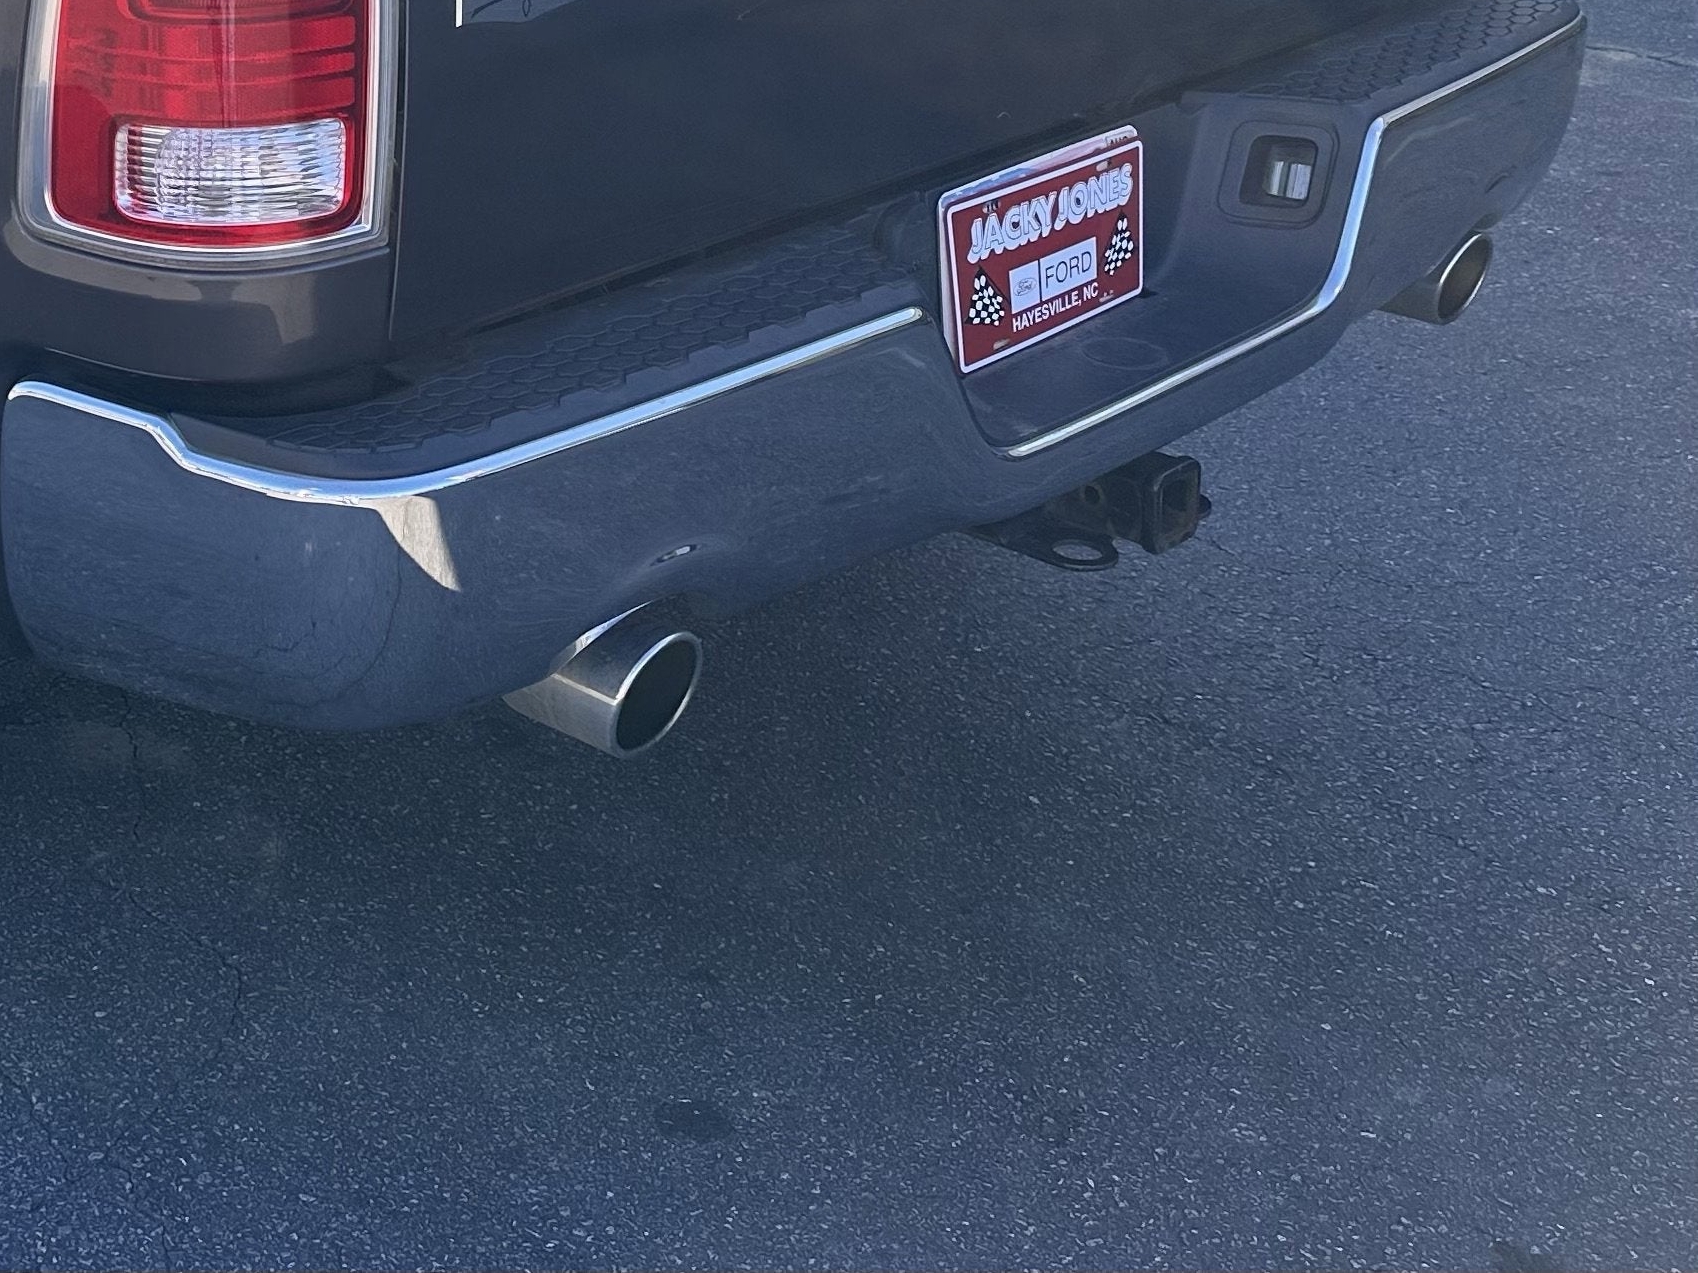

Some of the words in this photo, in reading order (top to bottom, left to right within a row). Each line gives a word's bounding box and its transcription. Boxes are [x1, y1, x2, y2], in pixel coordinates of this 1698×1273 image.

[966, 191, 1057, 264] JACKY
[1053, 162, 1134, 231] JONES
[1045, 251, 1092, 289] FORD
[1012, 290, 1082, 333] HAYESVILLE,
[1083, 281, 1099, 302] NC
